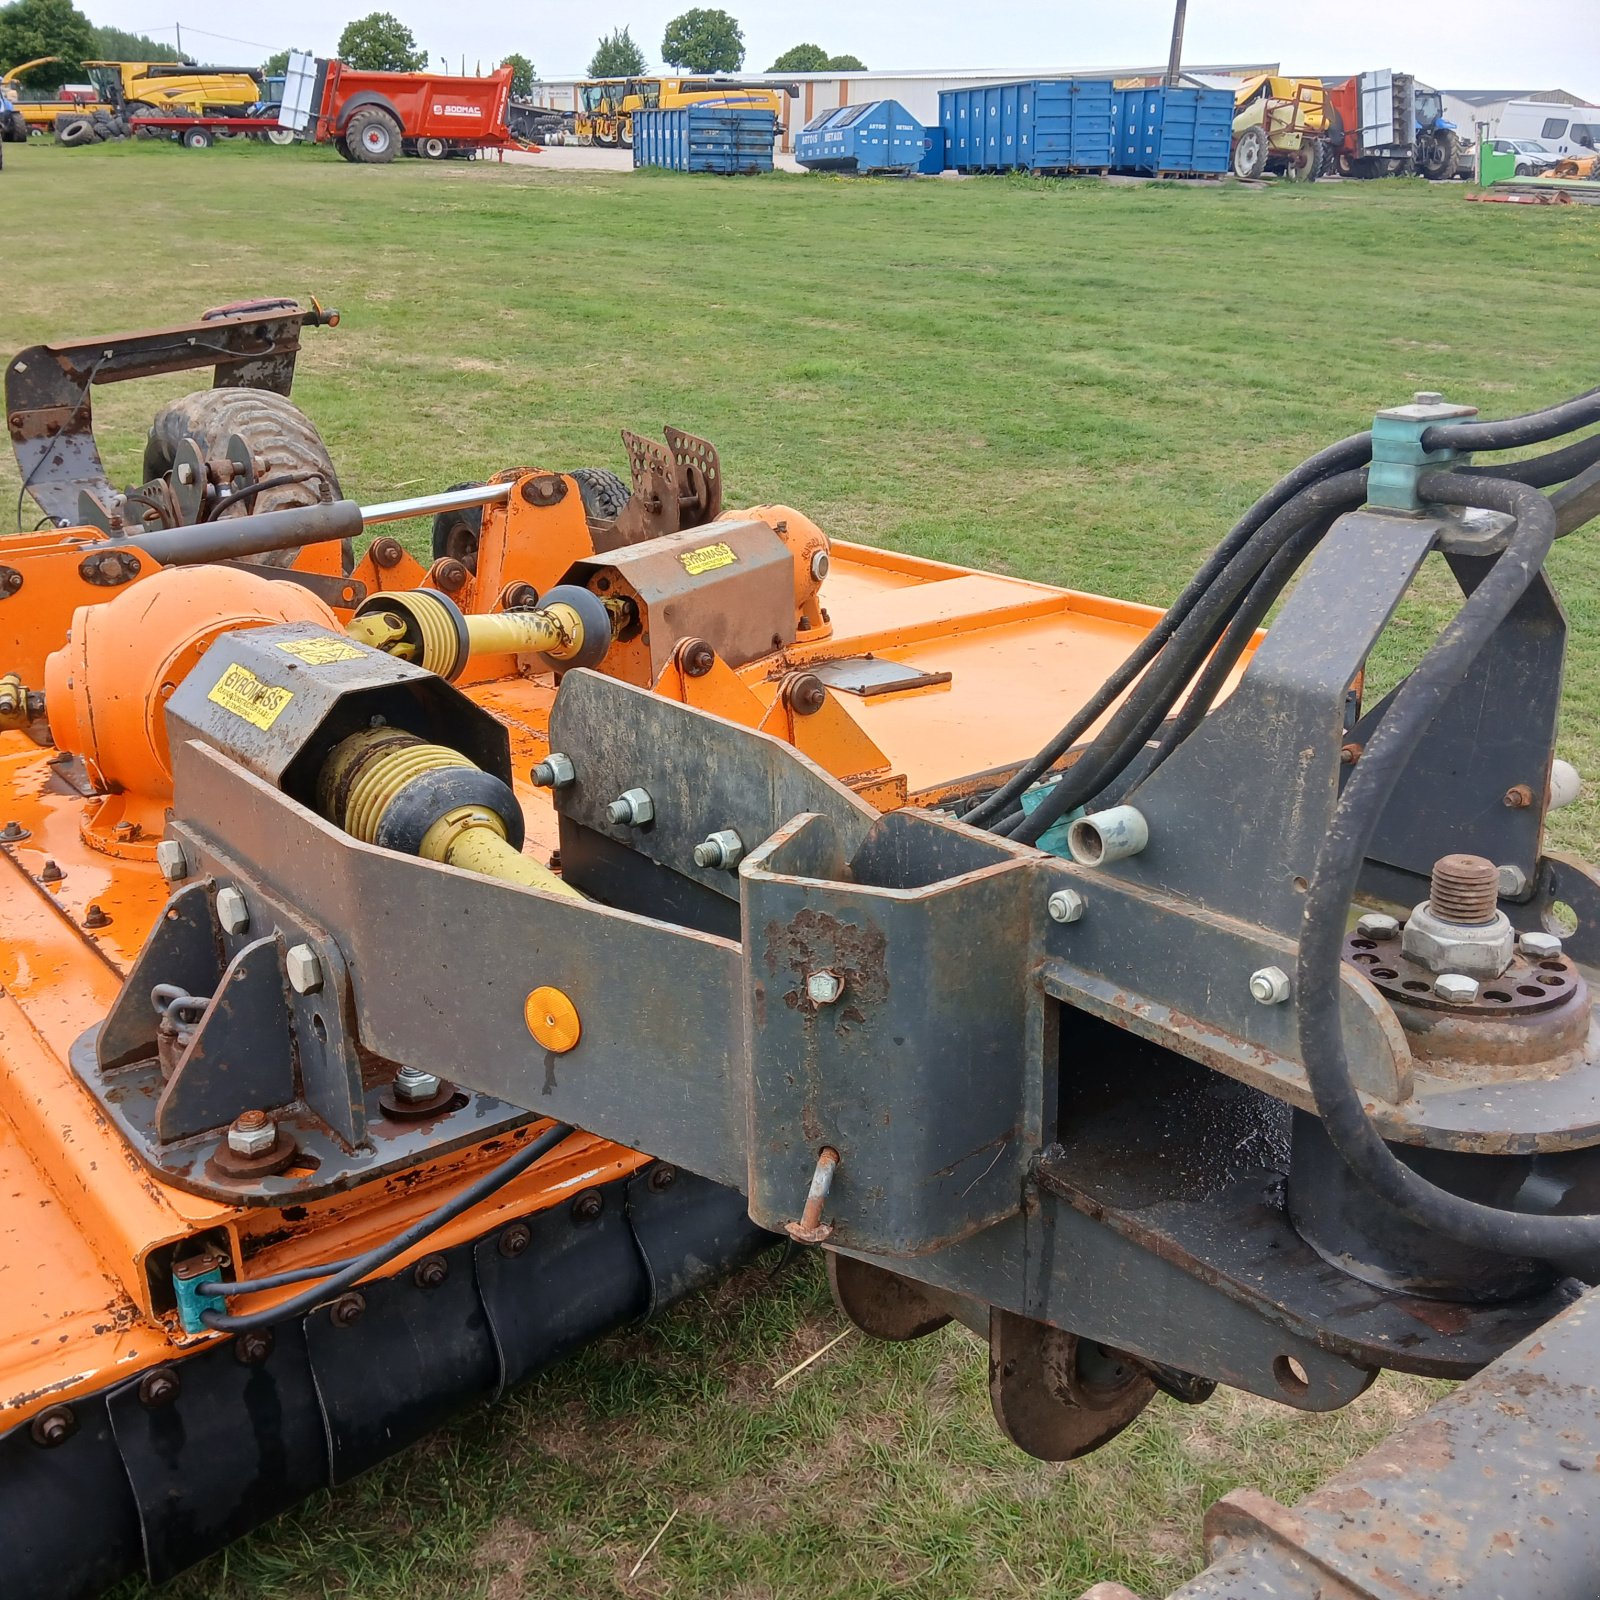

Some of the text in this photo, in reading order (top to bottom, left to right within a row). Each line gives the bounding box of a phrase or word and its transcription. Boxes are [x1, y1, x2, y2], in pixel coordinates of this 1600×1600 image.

[945, 103, 1029, 120] ARTOIS
[945, 134, 1028, 149] METAUX
[683, 545, 729, 567] GYROMASS
[224, 671, 284, 711] GYROMASS
